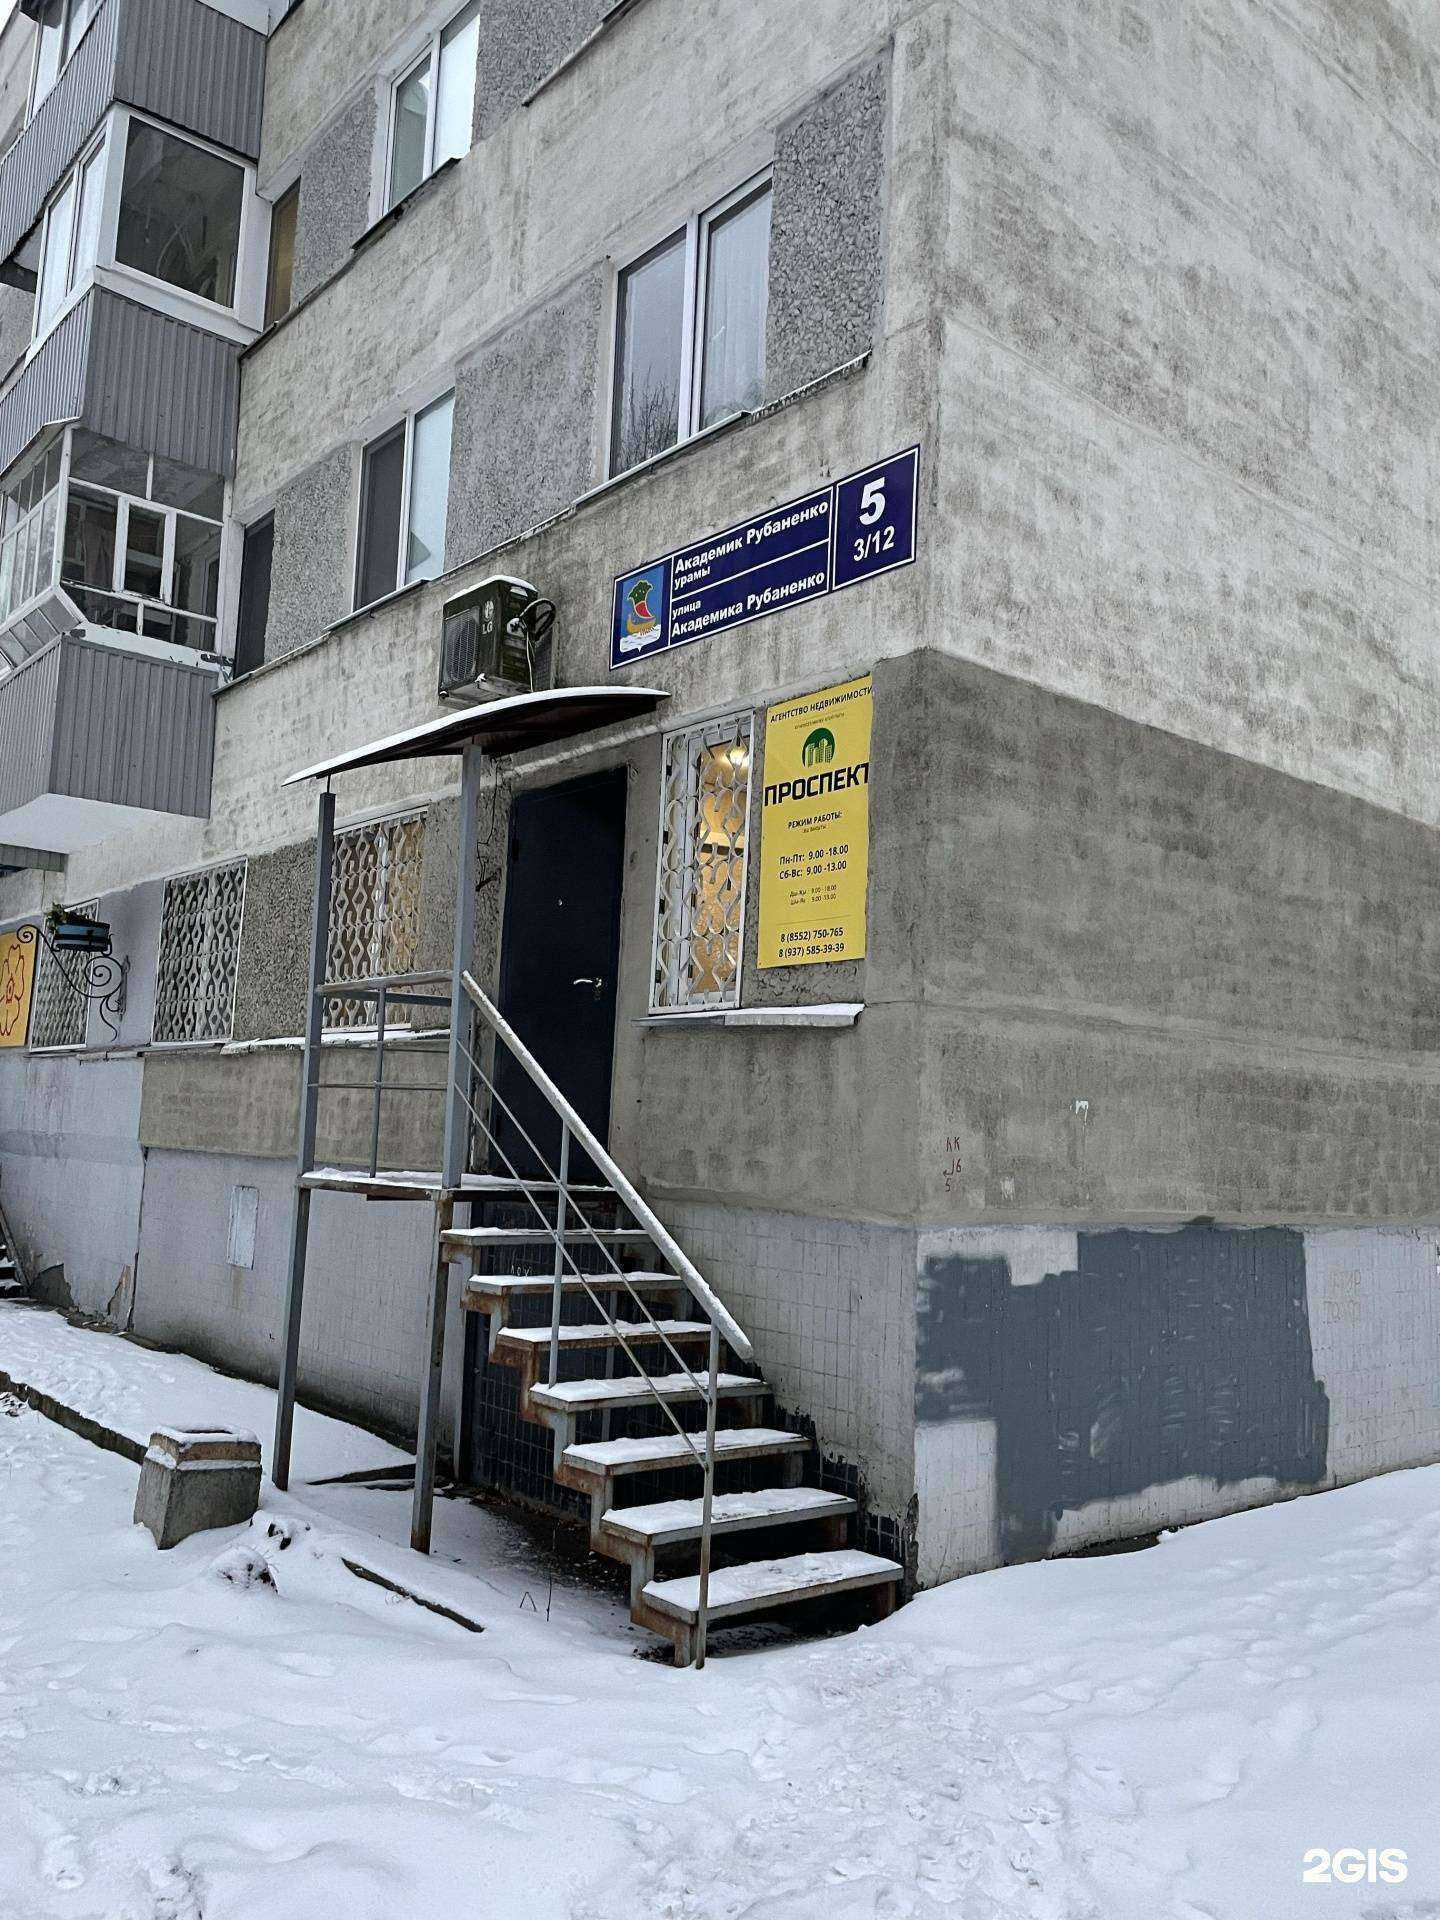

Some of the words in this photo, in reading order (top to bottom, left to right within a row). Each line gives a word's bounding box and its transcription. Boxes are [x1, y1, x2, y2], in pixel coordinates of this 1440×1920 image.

[859, 476, 886, 526] 5
[674, 537, 743, 573] Академик
[746, 501, 828, 545] Рубаненко
[853, 525, 895, 562] 3/12
[674, 566, 710, 590] урамы
[671, 602, 743, 637] Академика
[746, 572, 825, 610] Рубаненко
[672, 600, 701, 621] улица
[482, 621, 493, 635] LG
[770, 705, 809, 723] АГЕНТСТВО
[810, 686, 872, 712] НЕДВИЖИМОСТИ
[764, 762, 870, 806] ПРОСПЕКТ
[788, 817, 812, 829] РЕЖИМ
[780, 854, 805, 865] Пн-Пт:
[808, 849, 824, 860] 9.00
[780, 869, 803, 879] Сб-Вс:
[806, 865, 822, 876] 9.00
[780, 933, 786, 943] 8
[786, 930, 811, 943] (8552)
[813, 927, 844, 939] 750-765
[778, 949, 784, 957] 8
[785, 946, 805, 958] (937)
[806, 943, 845, 955] 585-39-39
